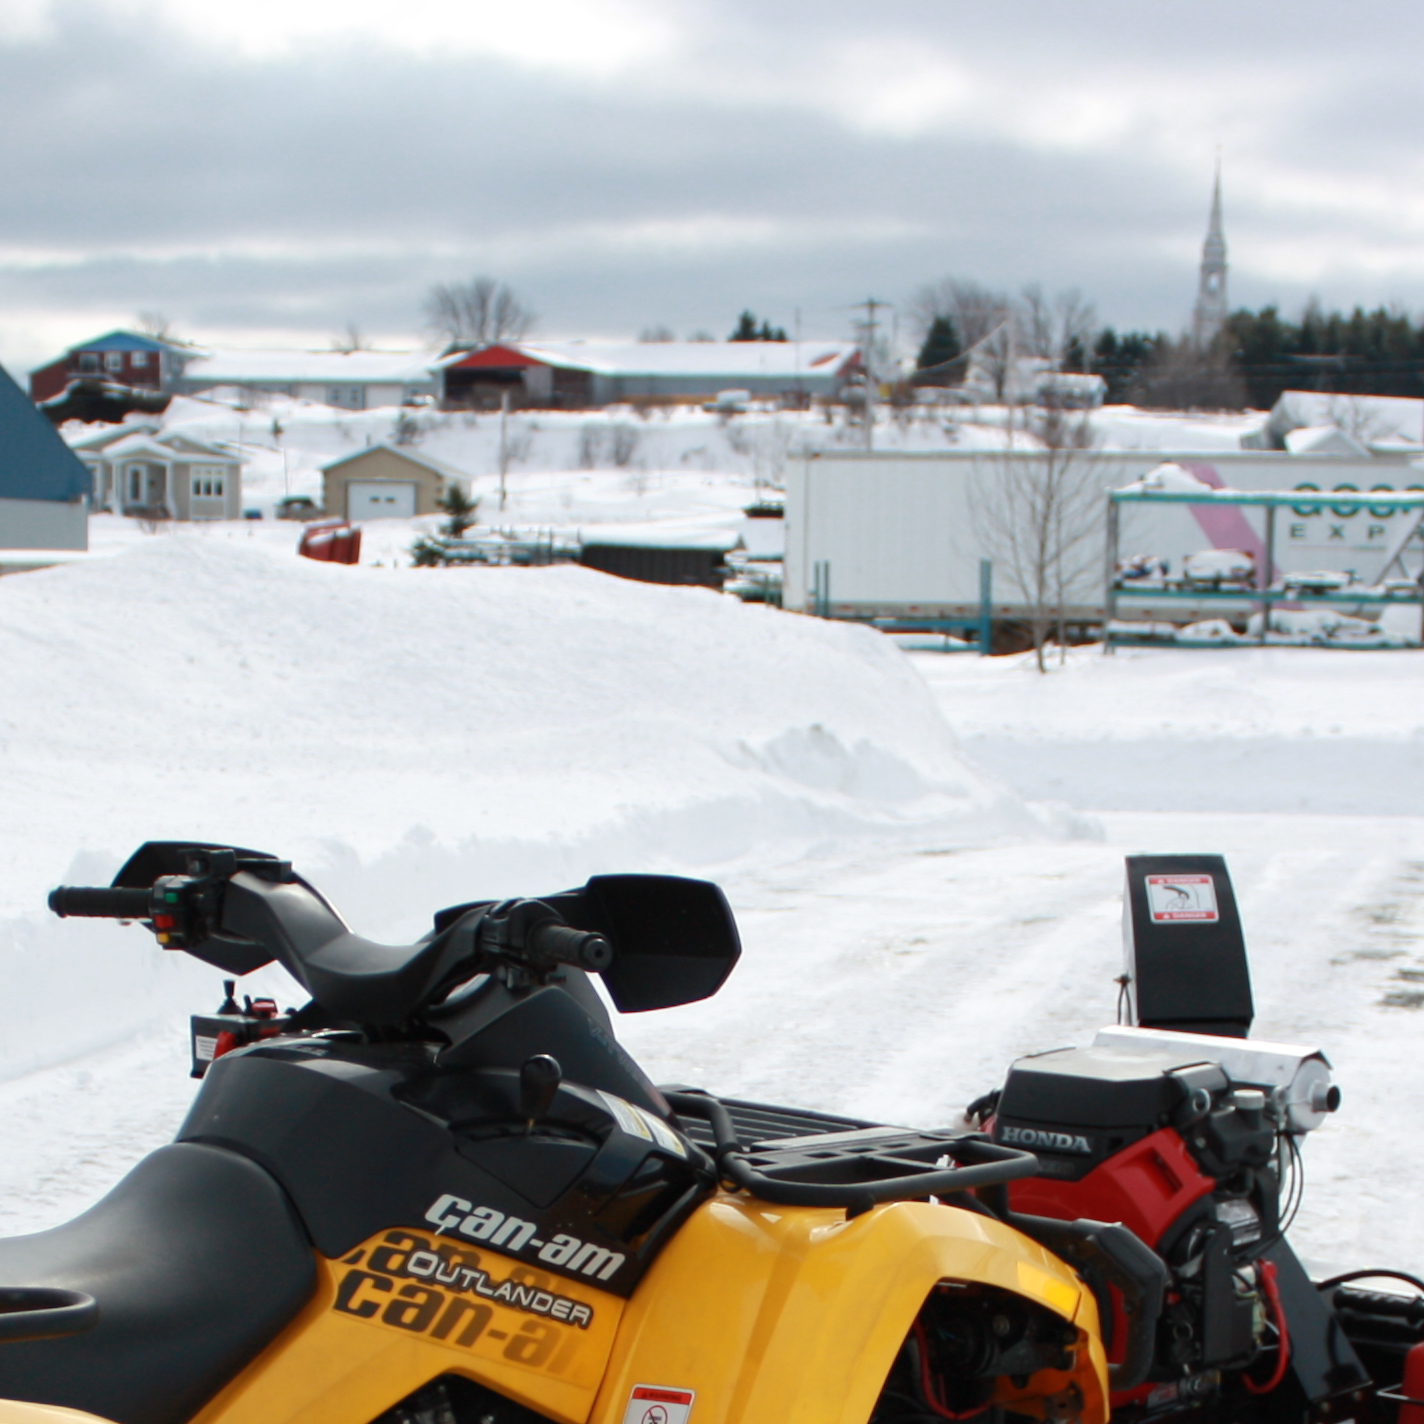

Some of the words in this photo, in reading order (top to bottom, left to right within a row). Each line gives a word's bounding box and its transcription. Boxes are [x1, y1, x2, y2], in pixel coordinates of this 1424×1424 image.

[1001, 1126, 1092, 1153] HONDA
[425, 1194, 626, 1281] can-am
[407, 1250, 592, 1326] OUTLANDER
